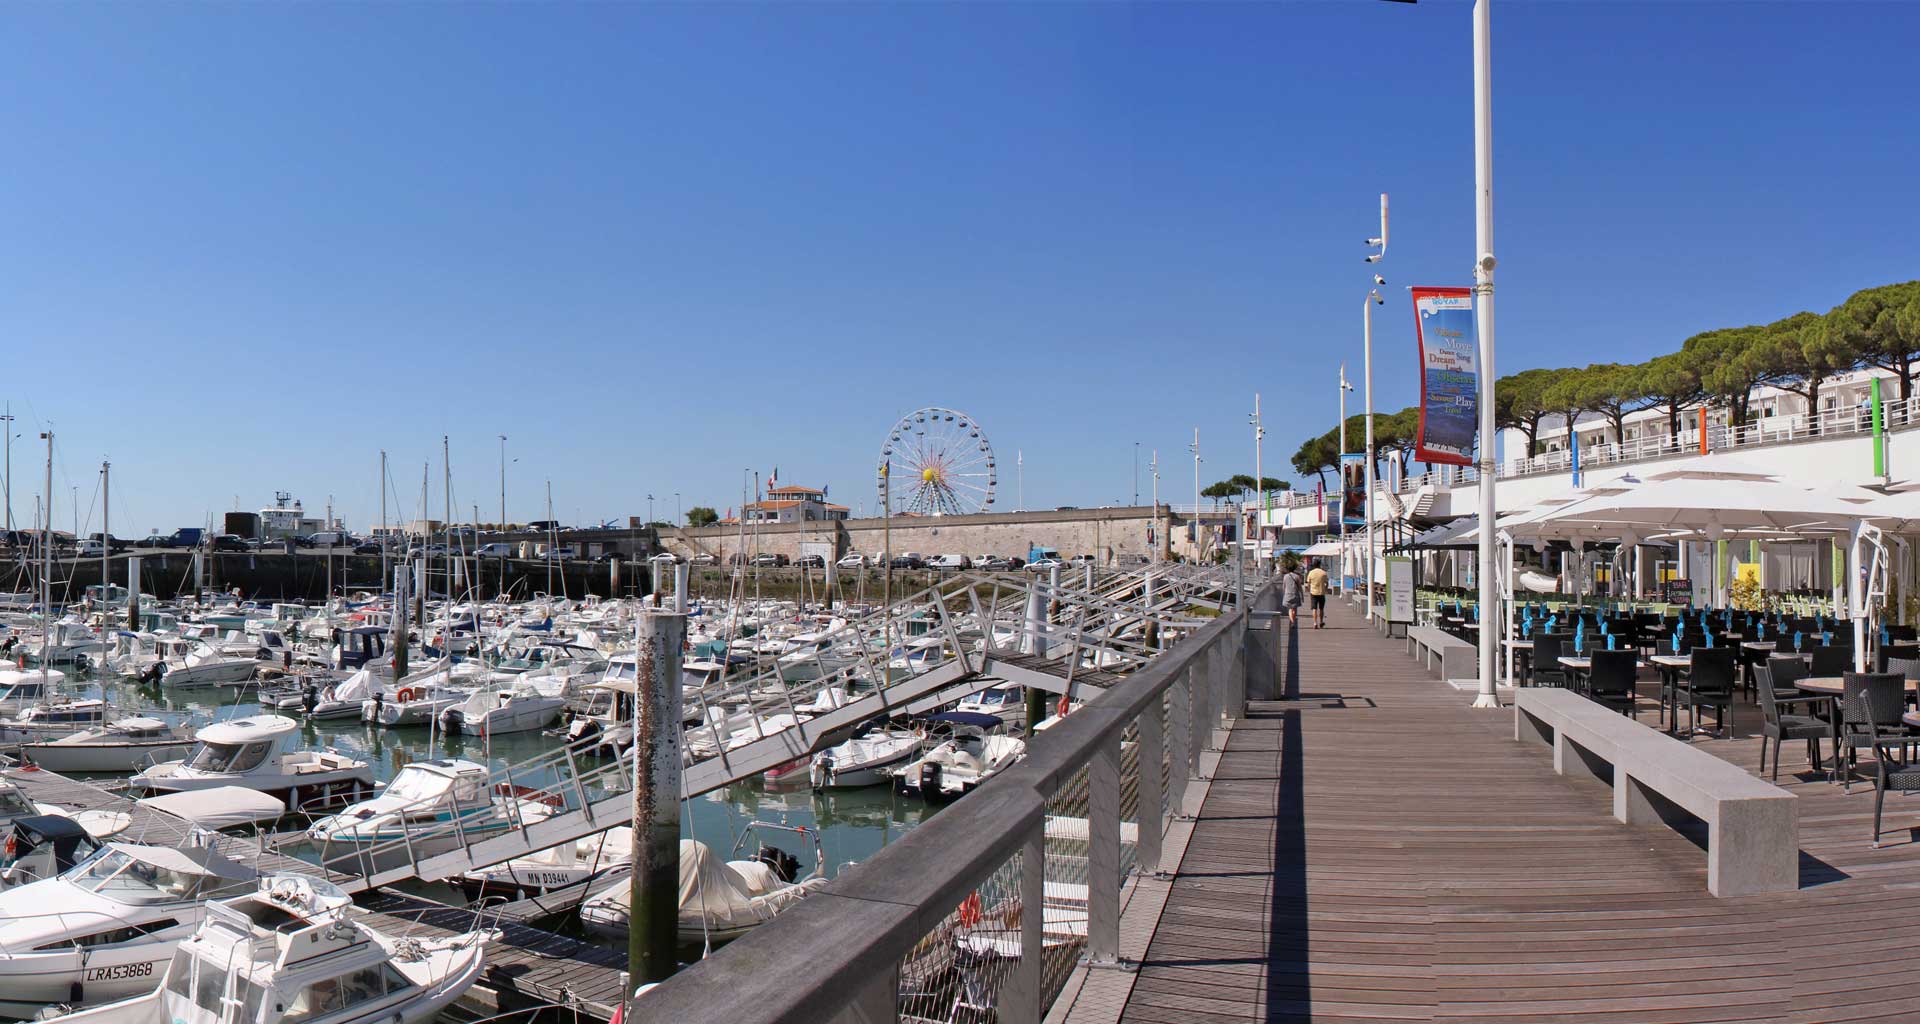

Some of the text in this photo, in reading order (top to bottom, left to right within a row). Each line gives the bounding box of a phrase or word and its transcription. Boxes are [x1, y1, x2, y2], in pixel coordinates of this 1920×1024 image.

[1445, 338, 1472, 349] Move
[1429, 353, 1456, 364] Dream
[1456, 351, 1471, 363] Sing
[1456, 396, 1473, 409] Play
[528, 873, 540, 884] MN
[87, 962, 153, 981] LRA53868
